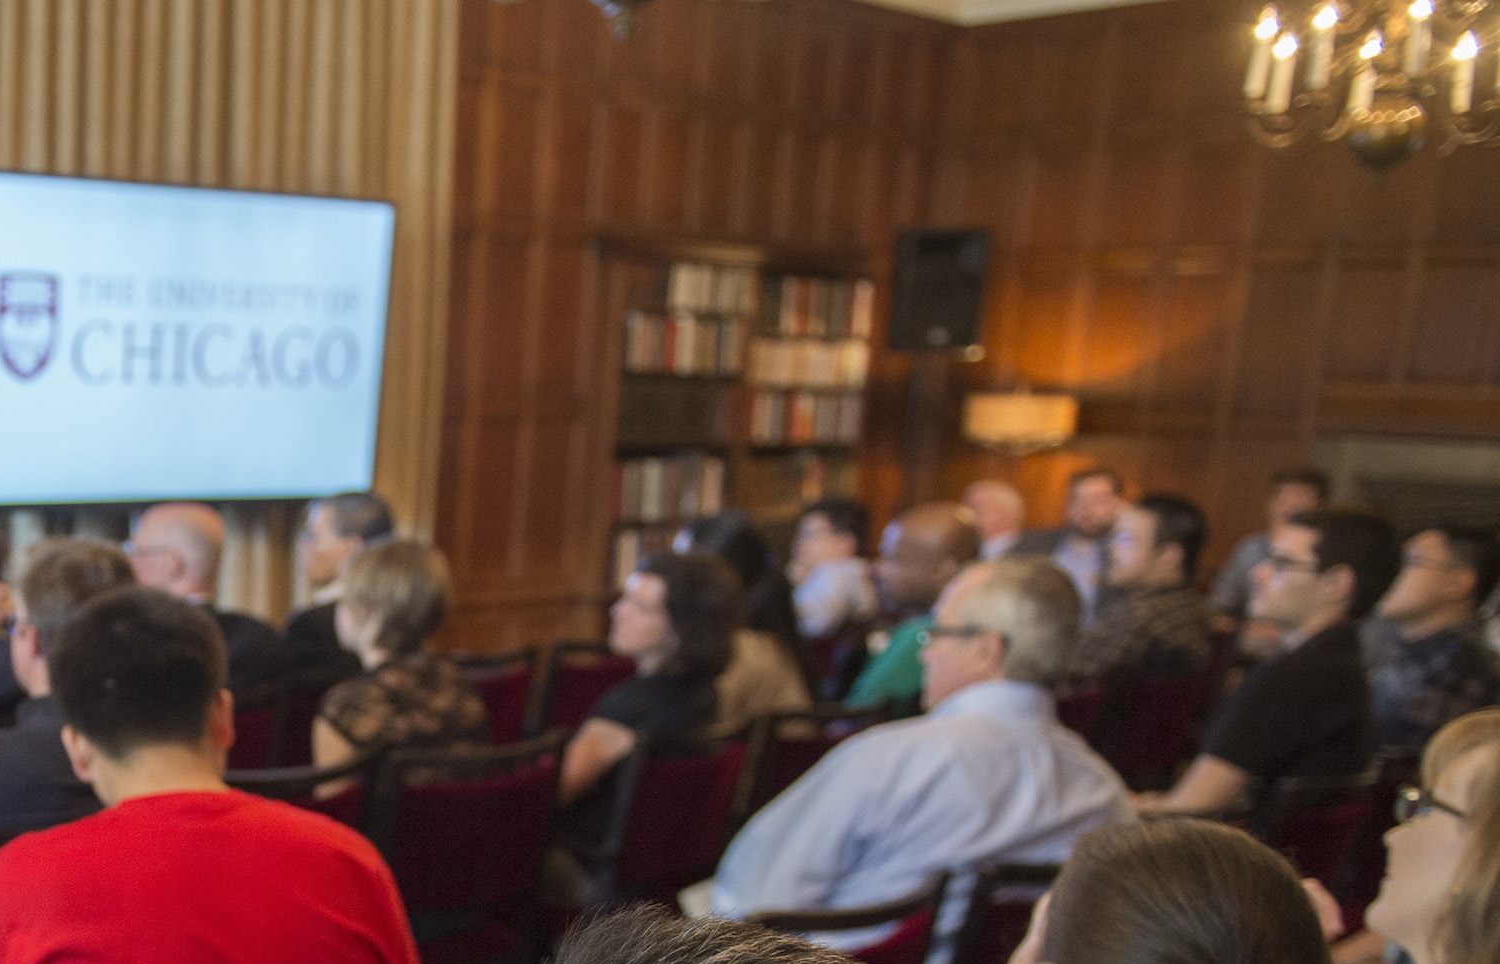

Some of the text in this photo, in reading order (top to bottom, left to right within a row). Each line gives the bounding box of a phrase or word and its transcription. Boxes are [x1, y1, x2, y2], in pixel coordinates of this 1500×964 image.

[78, 275, 135, 307] THE
[322, 285, 361, 316] OF
[70, 319, 360, 391] CHICAGO
